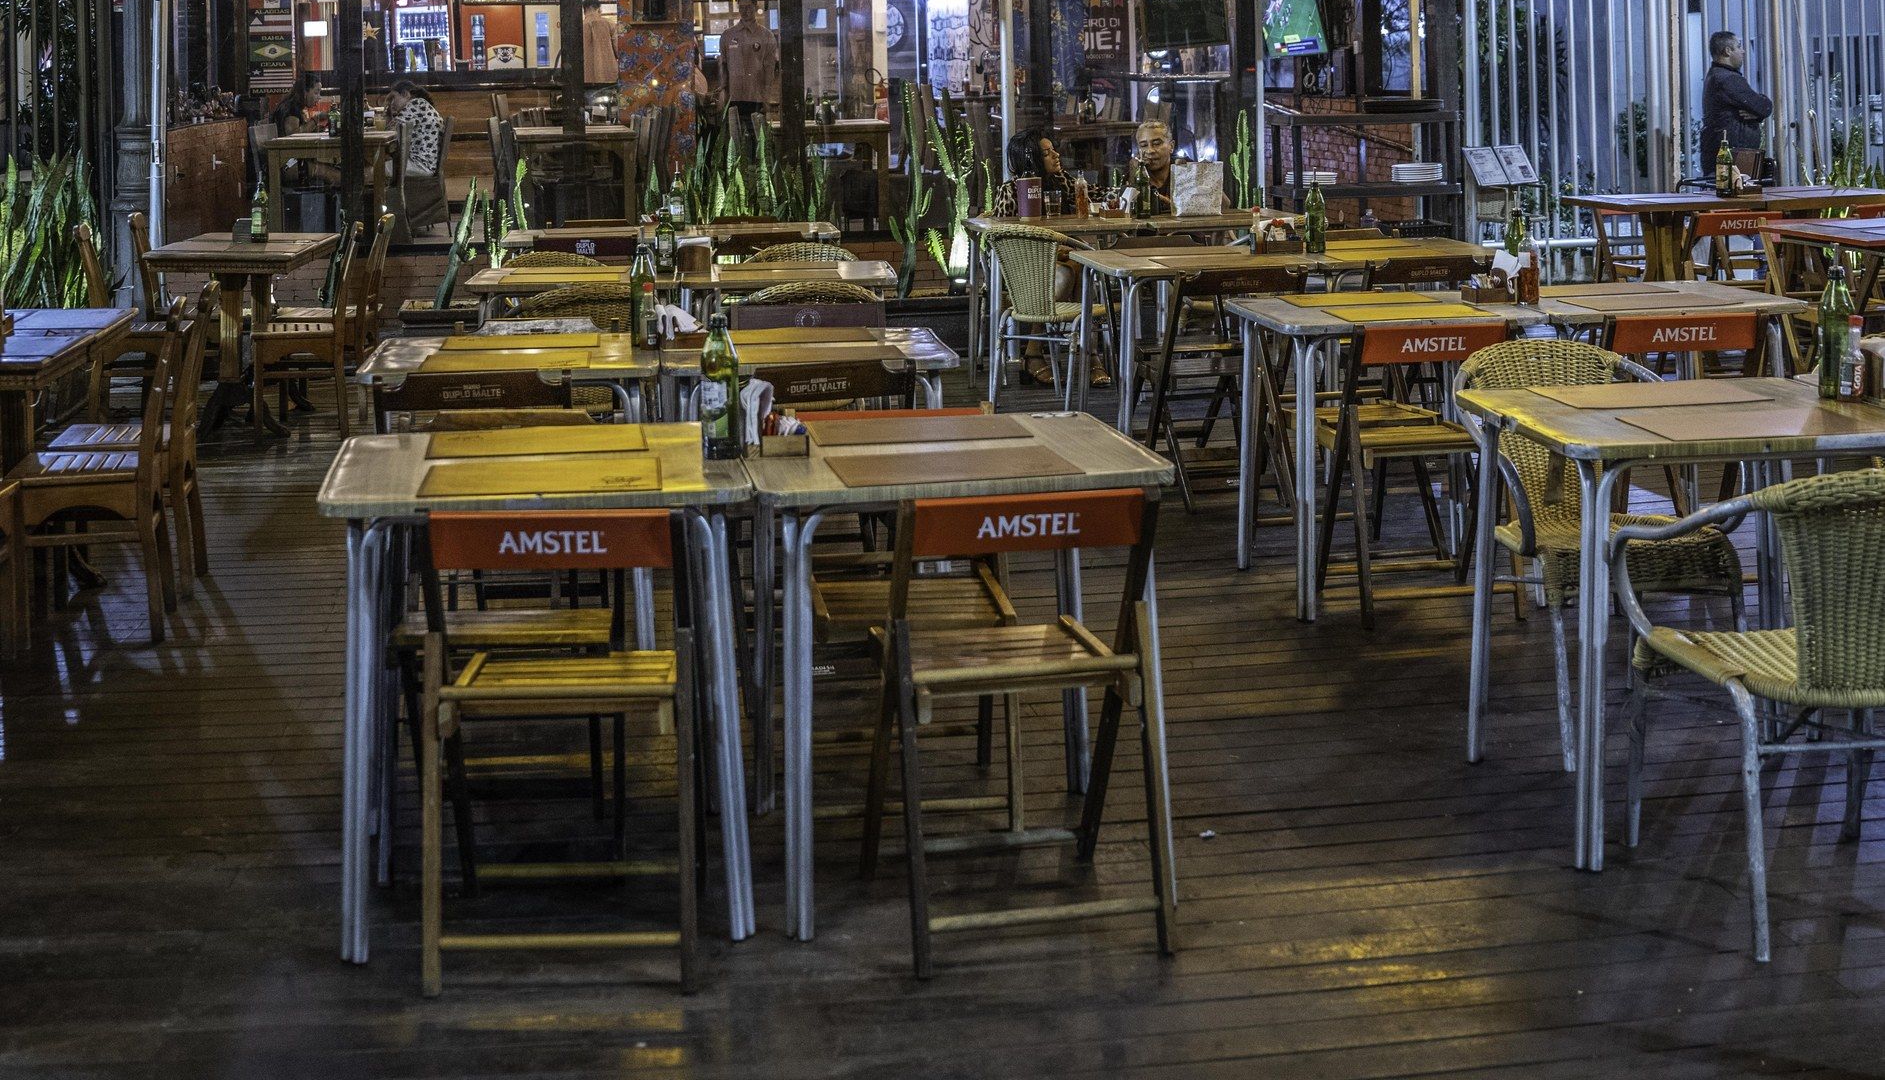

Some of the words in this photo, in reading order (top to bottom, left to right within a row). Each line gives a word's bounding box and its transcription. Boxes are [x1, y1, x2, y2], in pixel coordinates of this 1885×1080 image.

[1720, 219, 1758, 230] AMSTEL
[575, 241, 596, 249] DUPLO
[1652, 325, 1718, 343] AMSTEL
[1401, 336, 1467, 354] AMSTEL
[442, 389, 471, 399] DUPLO
[472, 387, 502, 398] MALTE
[790, 383, 817, 394] DUPLO
[818, 380, 847, 391] MALTE
[977, 513, 1081, 540] AMSTEL
[499, 530, 607, 556] AMSTEL
